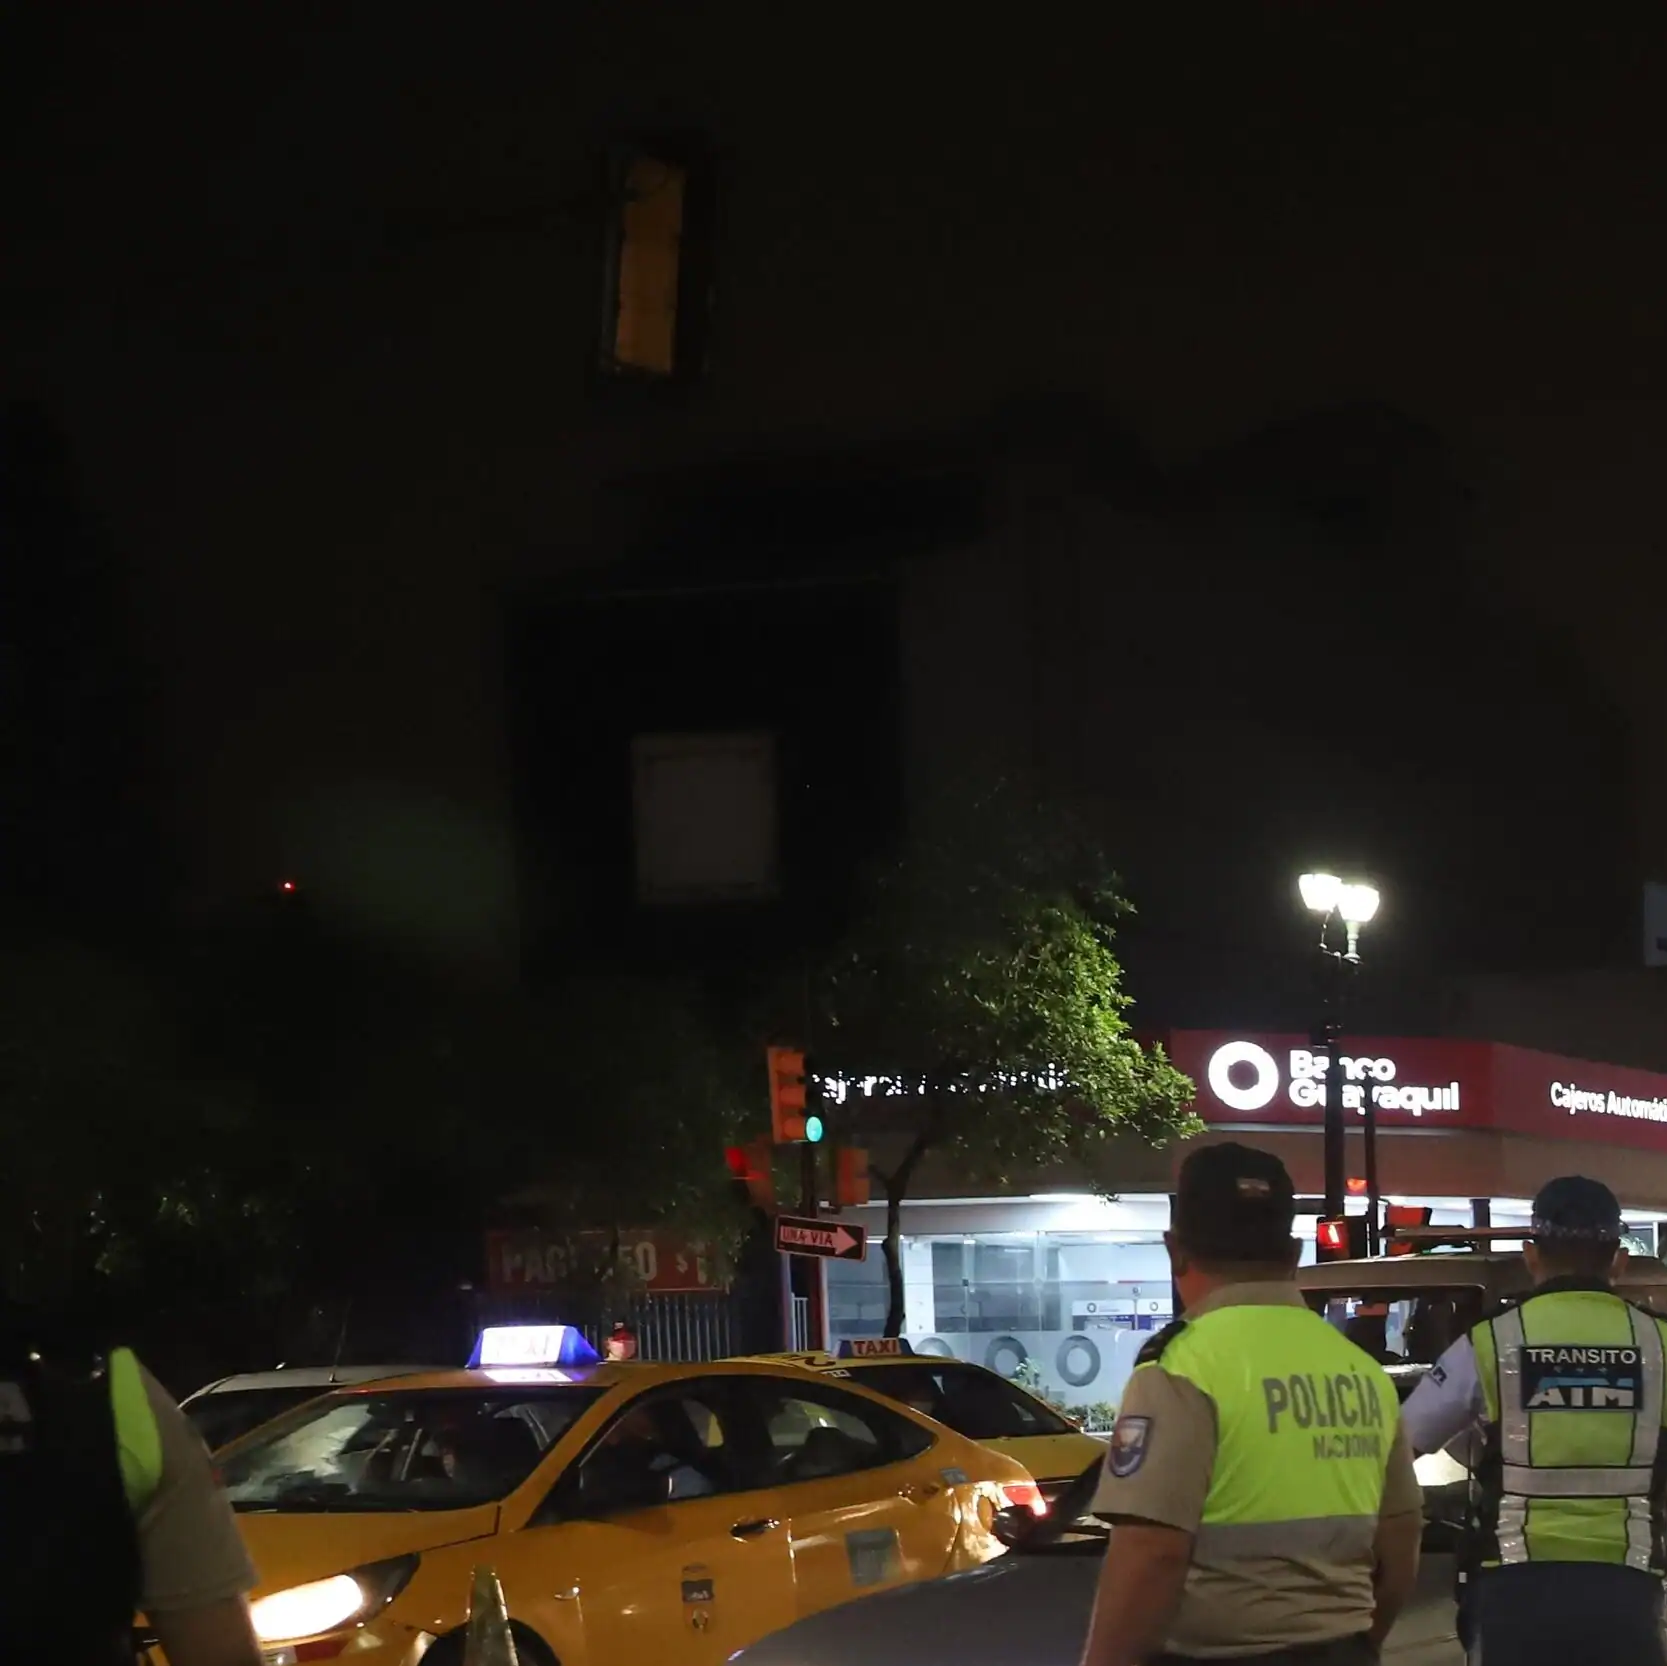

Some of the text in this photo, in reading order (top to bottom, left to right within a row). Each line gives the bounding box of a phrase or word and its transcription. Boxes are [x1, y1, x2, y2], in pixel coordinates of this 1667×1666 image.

[1550, 1081, 1605, 1115] Cajeros
[810, 1231, 833, 1247] VIA
[853, 1339, 898, 1356] TAXI
[1525, 1348, 1638, 1365] TRANSITO
